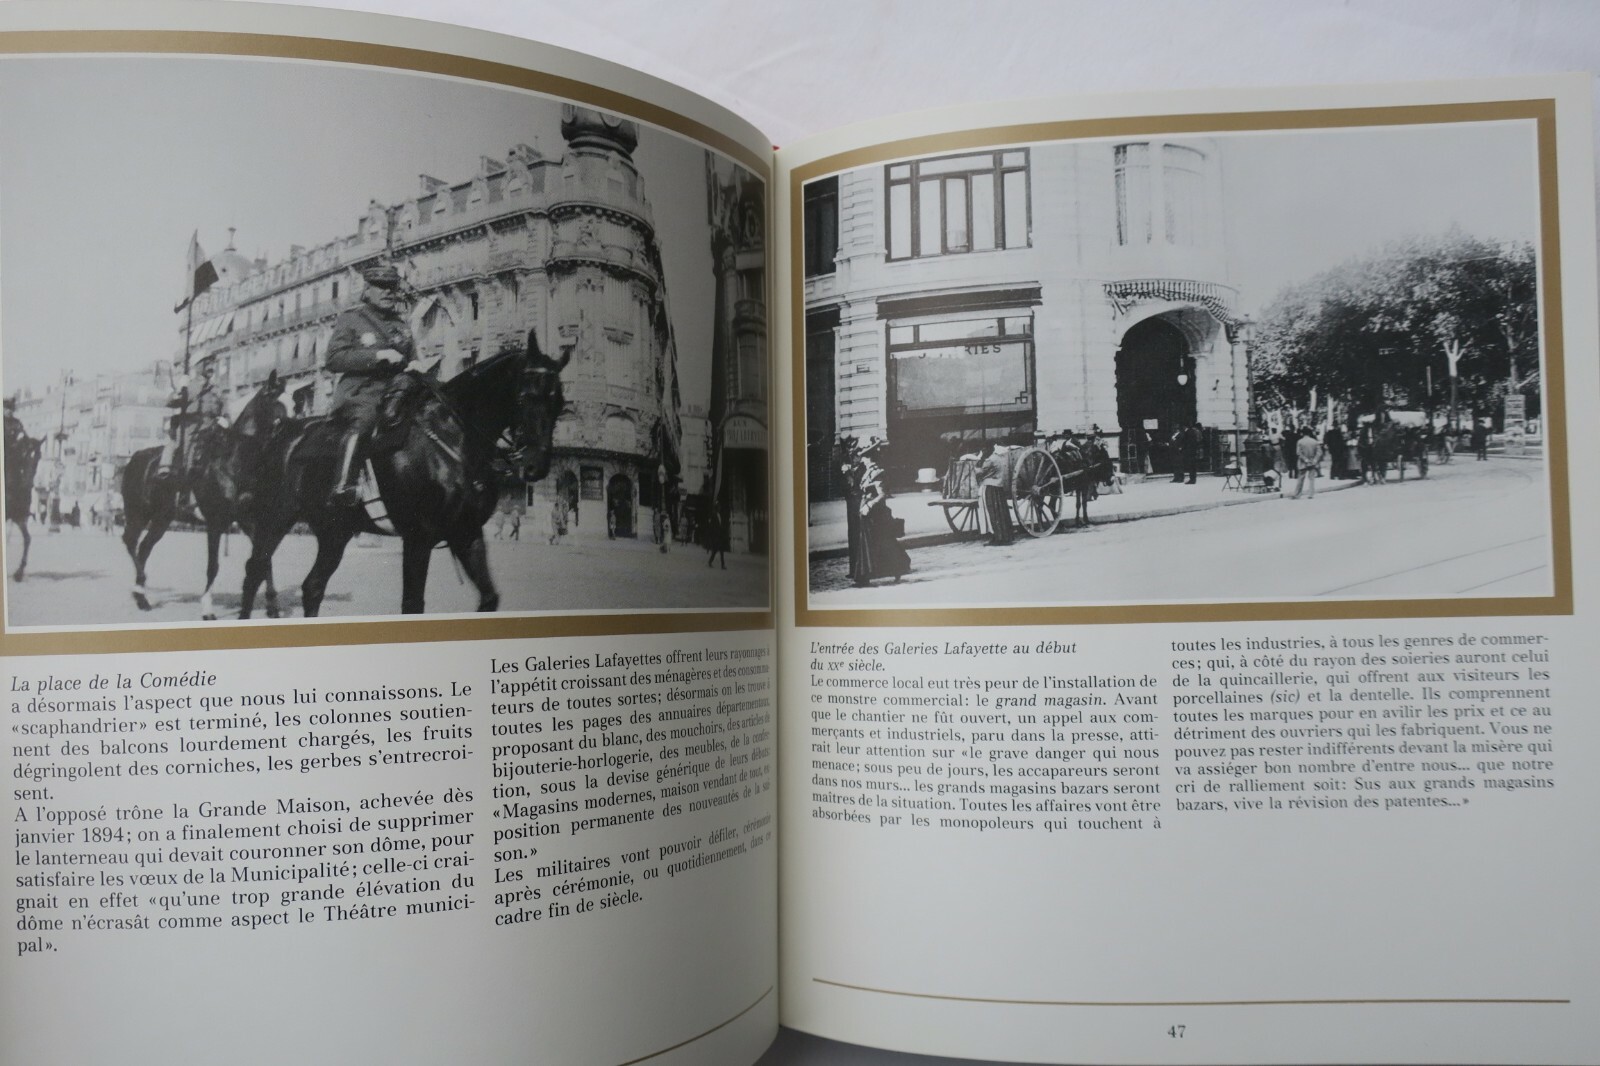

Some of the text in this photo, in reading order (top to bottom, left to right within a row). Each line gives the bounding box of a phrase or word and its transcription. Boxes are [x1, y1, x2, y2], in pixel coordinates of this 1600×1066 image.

[491, 659, 518, 673] Les
[525, 655, 590, 671] Galeries
[595, 653, 661, 670] Lafayettes
[666, 650, 702, 664] offrent
[706, 648, 728, 661] leurs
[810, 641, 1076, 657] L'entrée des Galeries Lafayette au début
[810, 658, 823, 670] du
[849, 659, 885, 671] siècle.
[11, 670, 216, 695] La place de la Comédie
[1172, 674, 1190, 687] de
[1198, 674, 1212, 686] la
[1326, 671, 1350, 687] qui
[1358, 670, 1408, 683] offrent
[1418, 673, 1445, 682] aux
[1453, 668, 1520, 681] visiteurs
[1528, 668, 1550, 680] les
[12, 682, 471, 713] a désormais l'aspect que nous lui connaissons. Le
[491, 702, 534, 715] teurs
[542, 697, 560, 712] de
[567, 696, 611, 710] toutes
[667, 684, 718, 701] désormais
[722, 686, 732, 696] on
[735, 682, 745, 694] les
[811, 694, 822, 702] ce
[828, 695, 876, 704] monstre
[976, 694, 988, 706] le
[995, 694, 1036, 709] grand
[1044, 693, 1106, 709] magasin.
[1114, 693, 1158, 705] Avant
[1173, 687, 1550, 708] porcellaines (sic) et la dentelle. Ils comprennent
[492, 722, 542, 736] toutes
[552, 717, 573, 731] les
[582, 716, 622, 732] pages
[630, 710, 651, 724] des
[658, 704, 711, 721] annuaires
[1174, 722, 1552, 740] détriment des ouvriers qui les fabriquent. Vous ne
[13, 724, 472, 756] nent des balcons lourdement chargés, les fruits
[812, 727, 1158, 744] merçants et industriels, paru dans la presse, atti-
[864, 764, 892, 773] sous
[898, 766, 921, 777] peu
[927, 763, 942, 775] de
[948, 763, 988, 778] jours,
[993, 764, 1013, 776] les
[1018, 768, 1107, 780] accapareurs
[1113, 765, 1160, 776] seront
[1176, 780, 1195, 793] cri
[1204, 780, 1220, 792] de
[1229, 779, 1304, 792] ralliement
[1354, 777, 1381, 790] Sus
[1389, 780, 1416, 789] aux
[1424, 776, 1475, 792] grands
[1484, 775, 1554, 791] magasins
[494, 783, 760, 845] position permanente des nouveautés de la
[812, 806, 1161, 832] absorbées par les monopoleurs qui touchent à
[16, 828, 74, 848] janvier
[138, 831, 159, 841] on
[166, 830, 176, 840] a
[182, 824, 281, 840] finalement
[288, 818, 342, 836] choisi
[350, 817, 370, 832] de
[378, 811, 474, 832] supprimer
[16, 834, 474, 868] le lanterneau qui devait couronner son dôme, pour
[494, 868, 523, 883] Les
[536, 856, 610, 878] militaires
[621, 848, 650, 864] vont
[659, 836, 702, 860] pouvoir
[709, 827, 738, 845] défiler,
[17, 894, 475, 930] dôme n'écrasât comme aspect le Théâtre munici-
[495, 889, 642, 926] cadre fin de siècle.
[1168, 1025, 1186, 1038] 47
